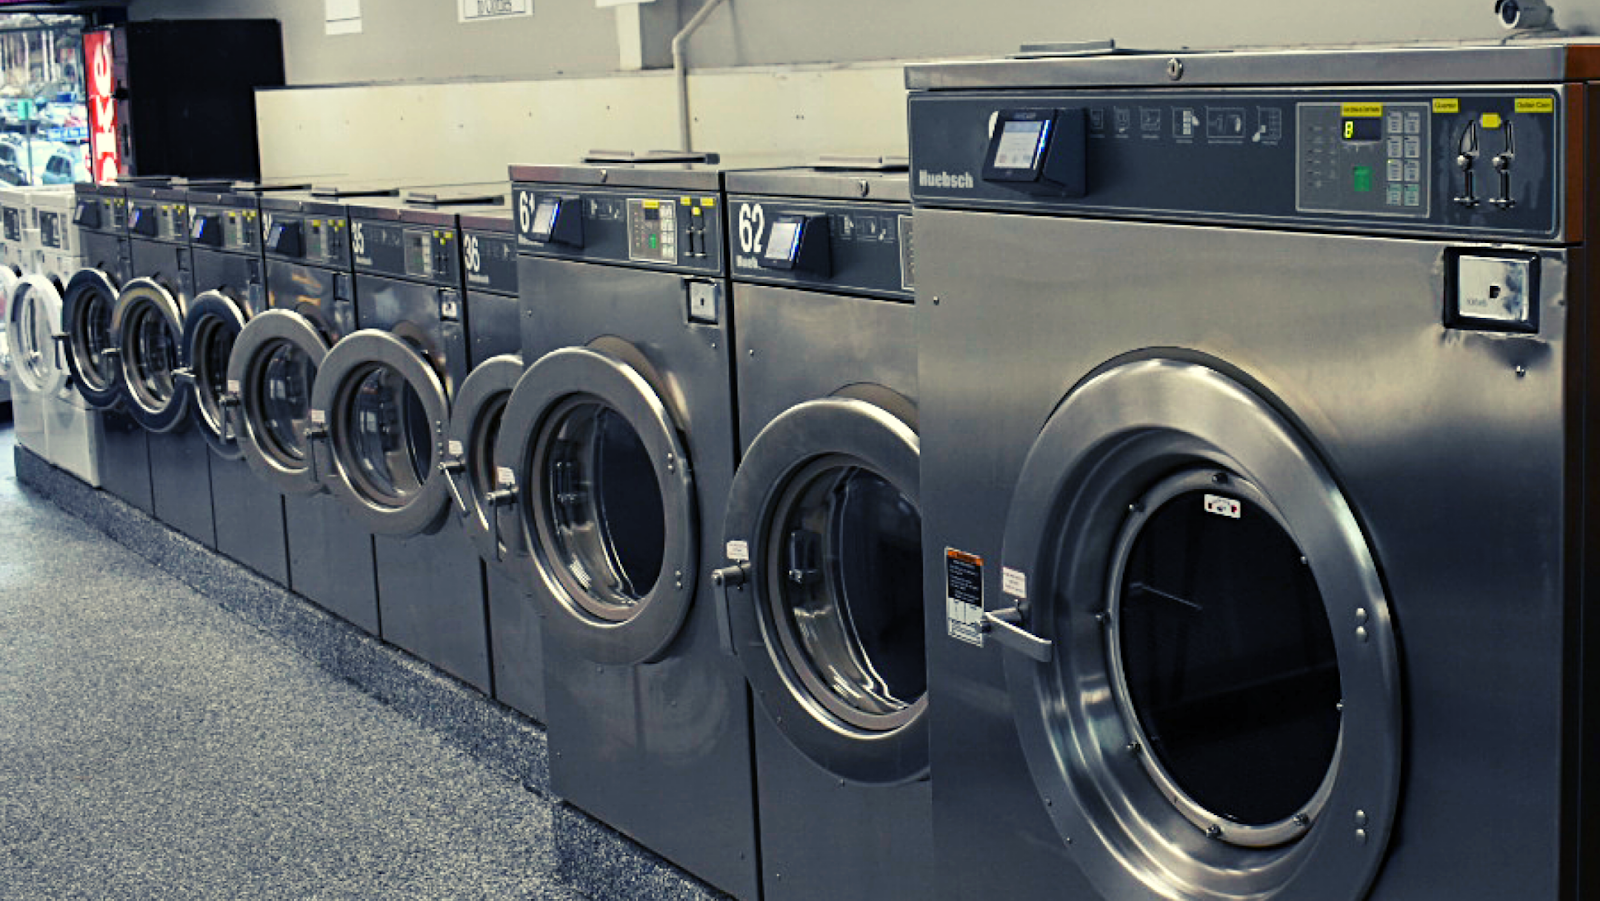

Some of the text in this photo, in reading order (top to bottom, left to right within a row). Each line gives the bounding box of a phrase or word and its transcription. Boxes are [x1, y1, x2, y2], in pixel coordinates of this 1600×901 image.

[918, 169, 974, 189] Huebsch
[351, 221, 365, 254] 35
[738, 203, 765, 253] 62
[463, 233, 480, 272] 36
